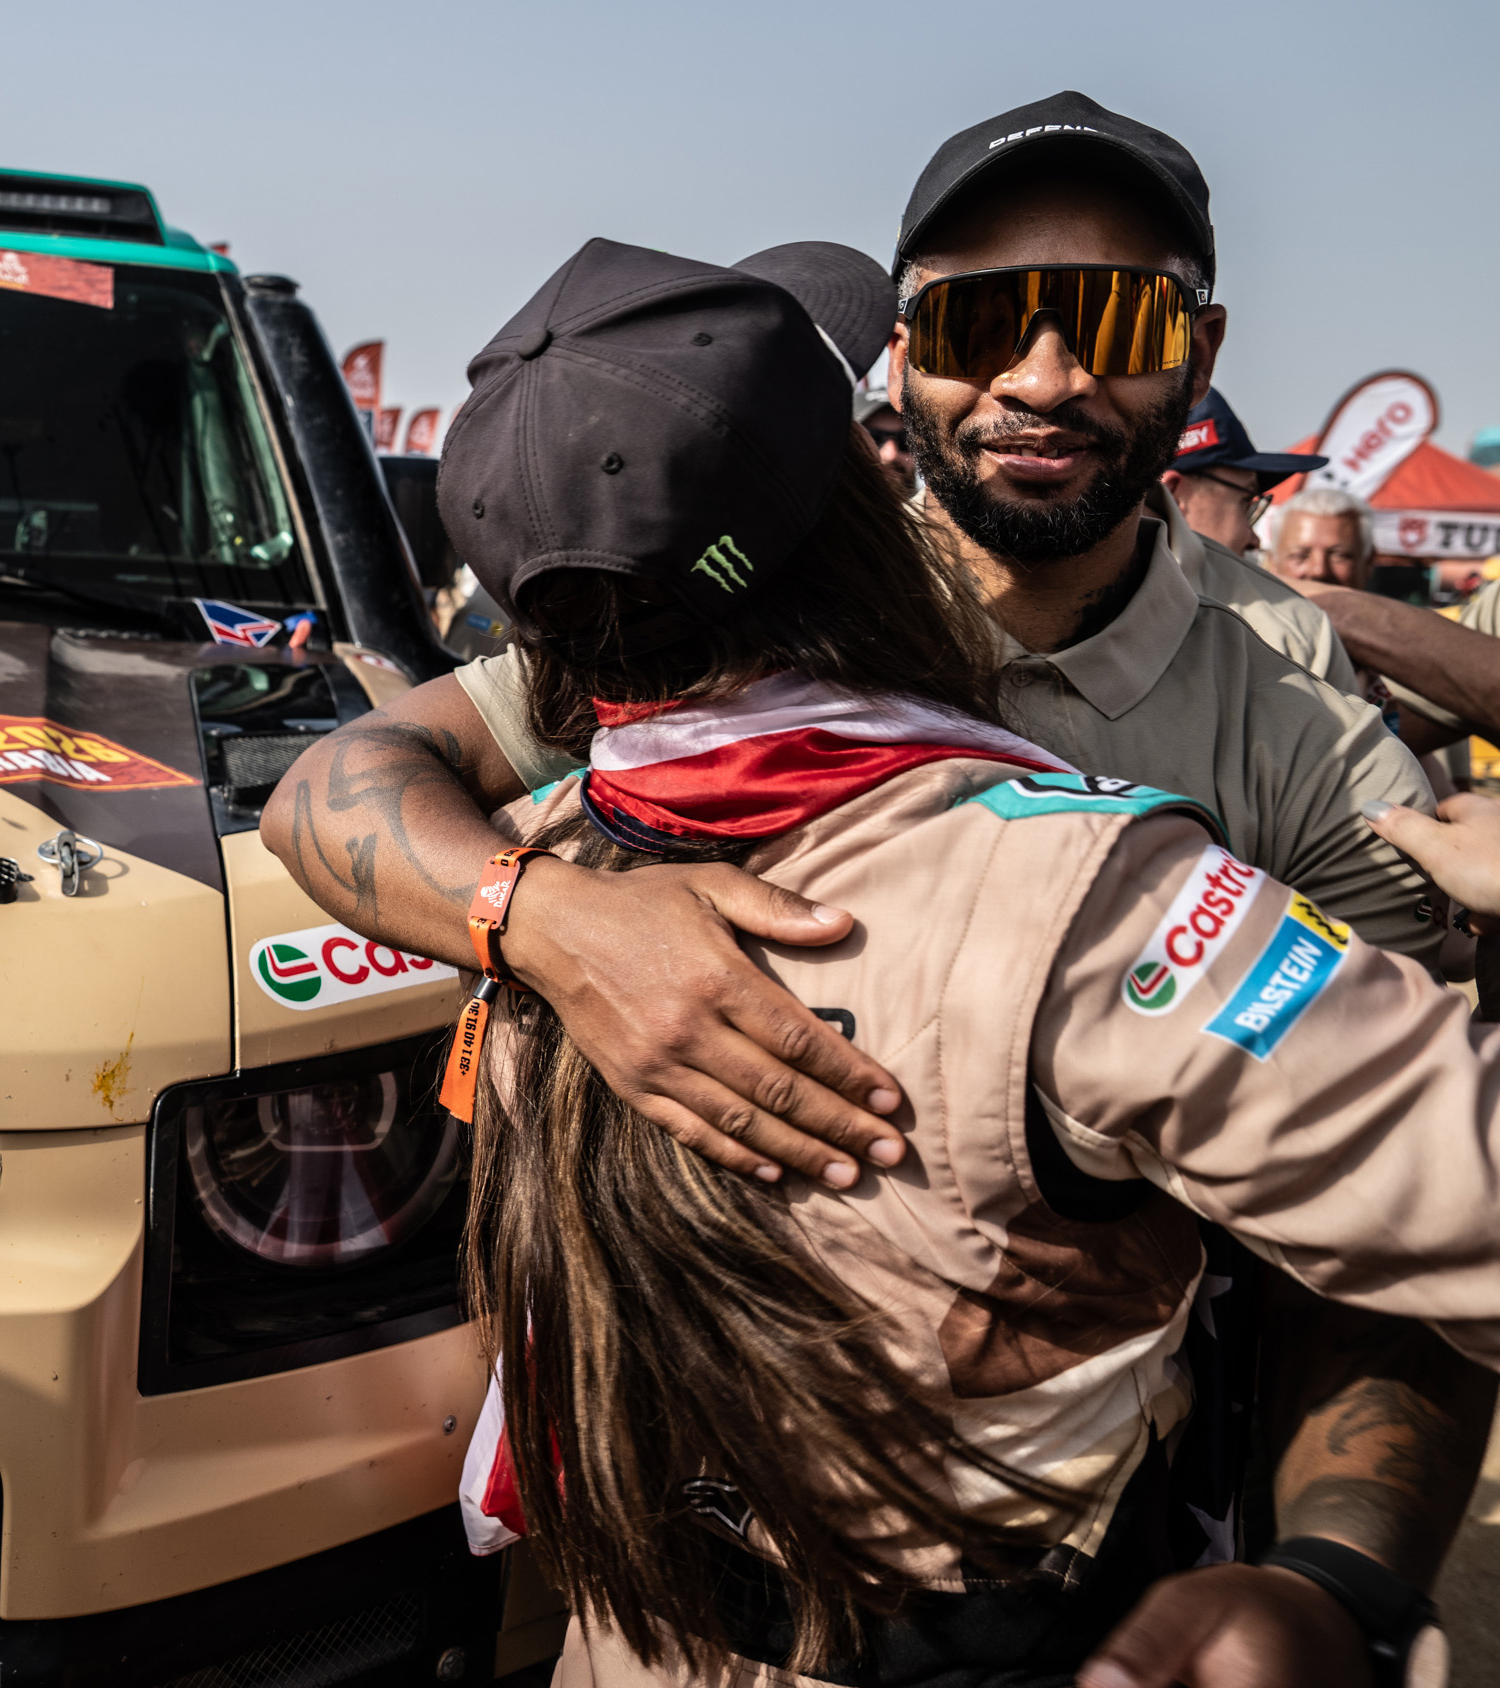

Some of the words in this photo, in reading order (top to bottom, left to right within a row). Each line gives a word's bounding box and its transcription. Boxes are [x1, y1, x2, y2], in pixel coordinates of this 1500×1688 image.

[1177, 425, 1209, 450] BY
[1436, 519, 1500, 551] TU
[1233, 935, 1324, 1034] BILSTEIN
[465, 1016, 478, 1032] 91
[464, 1031, 476, 1049] 40
